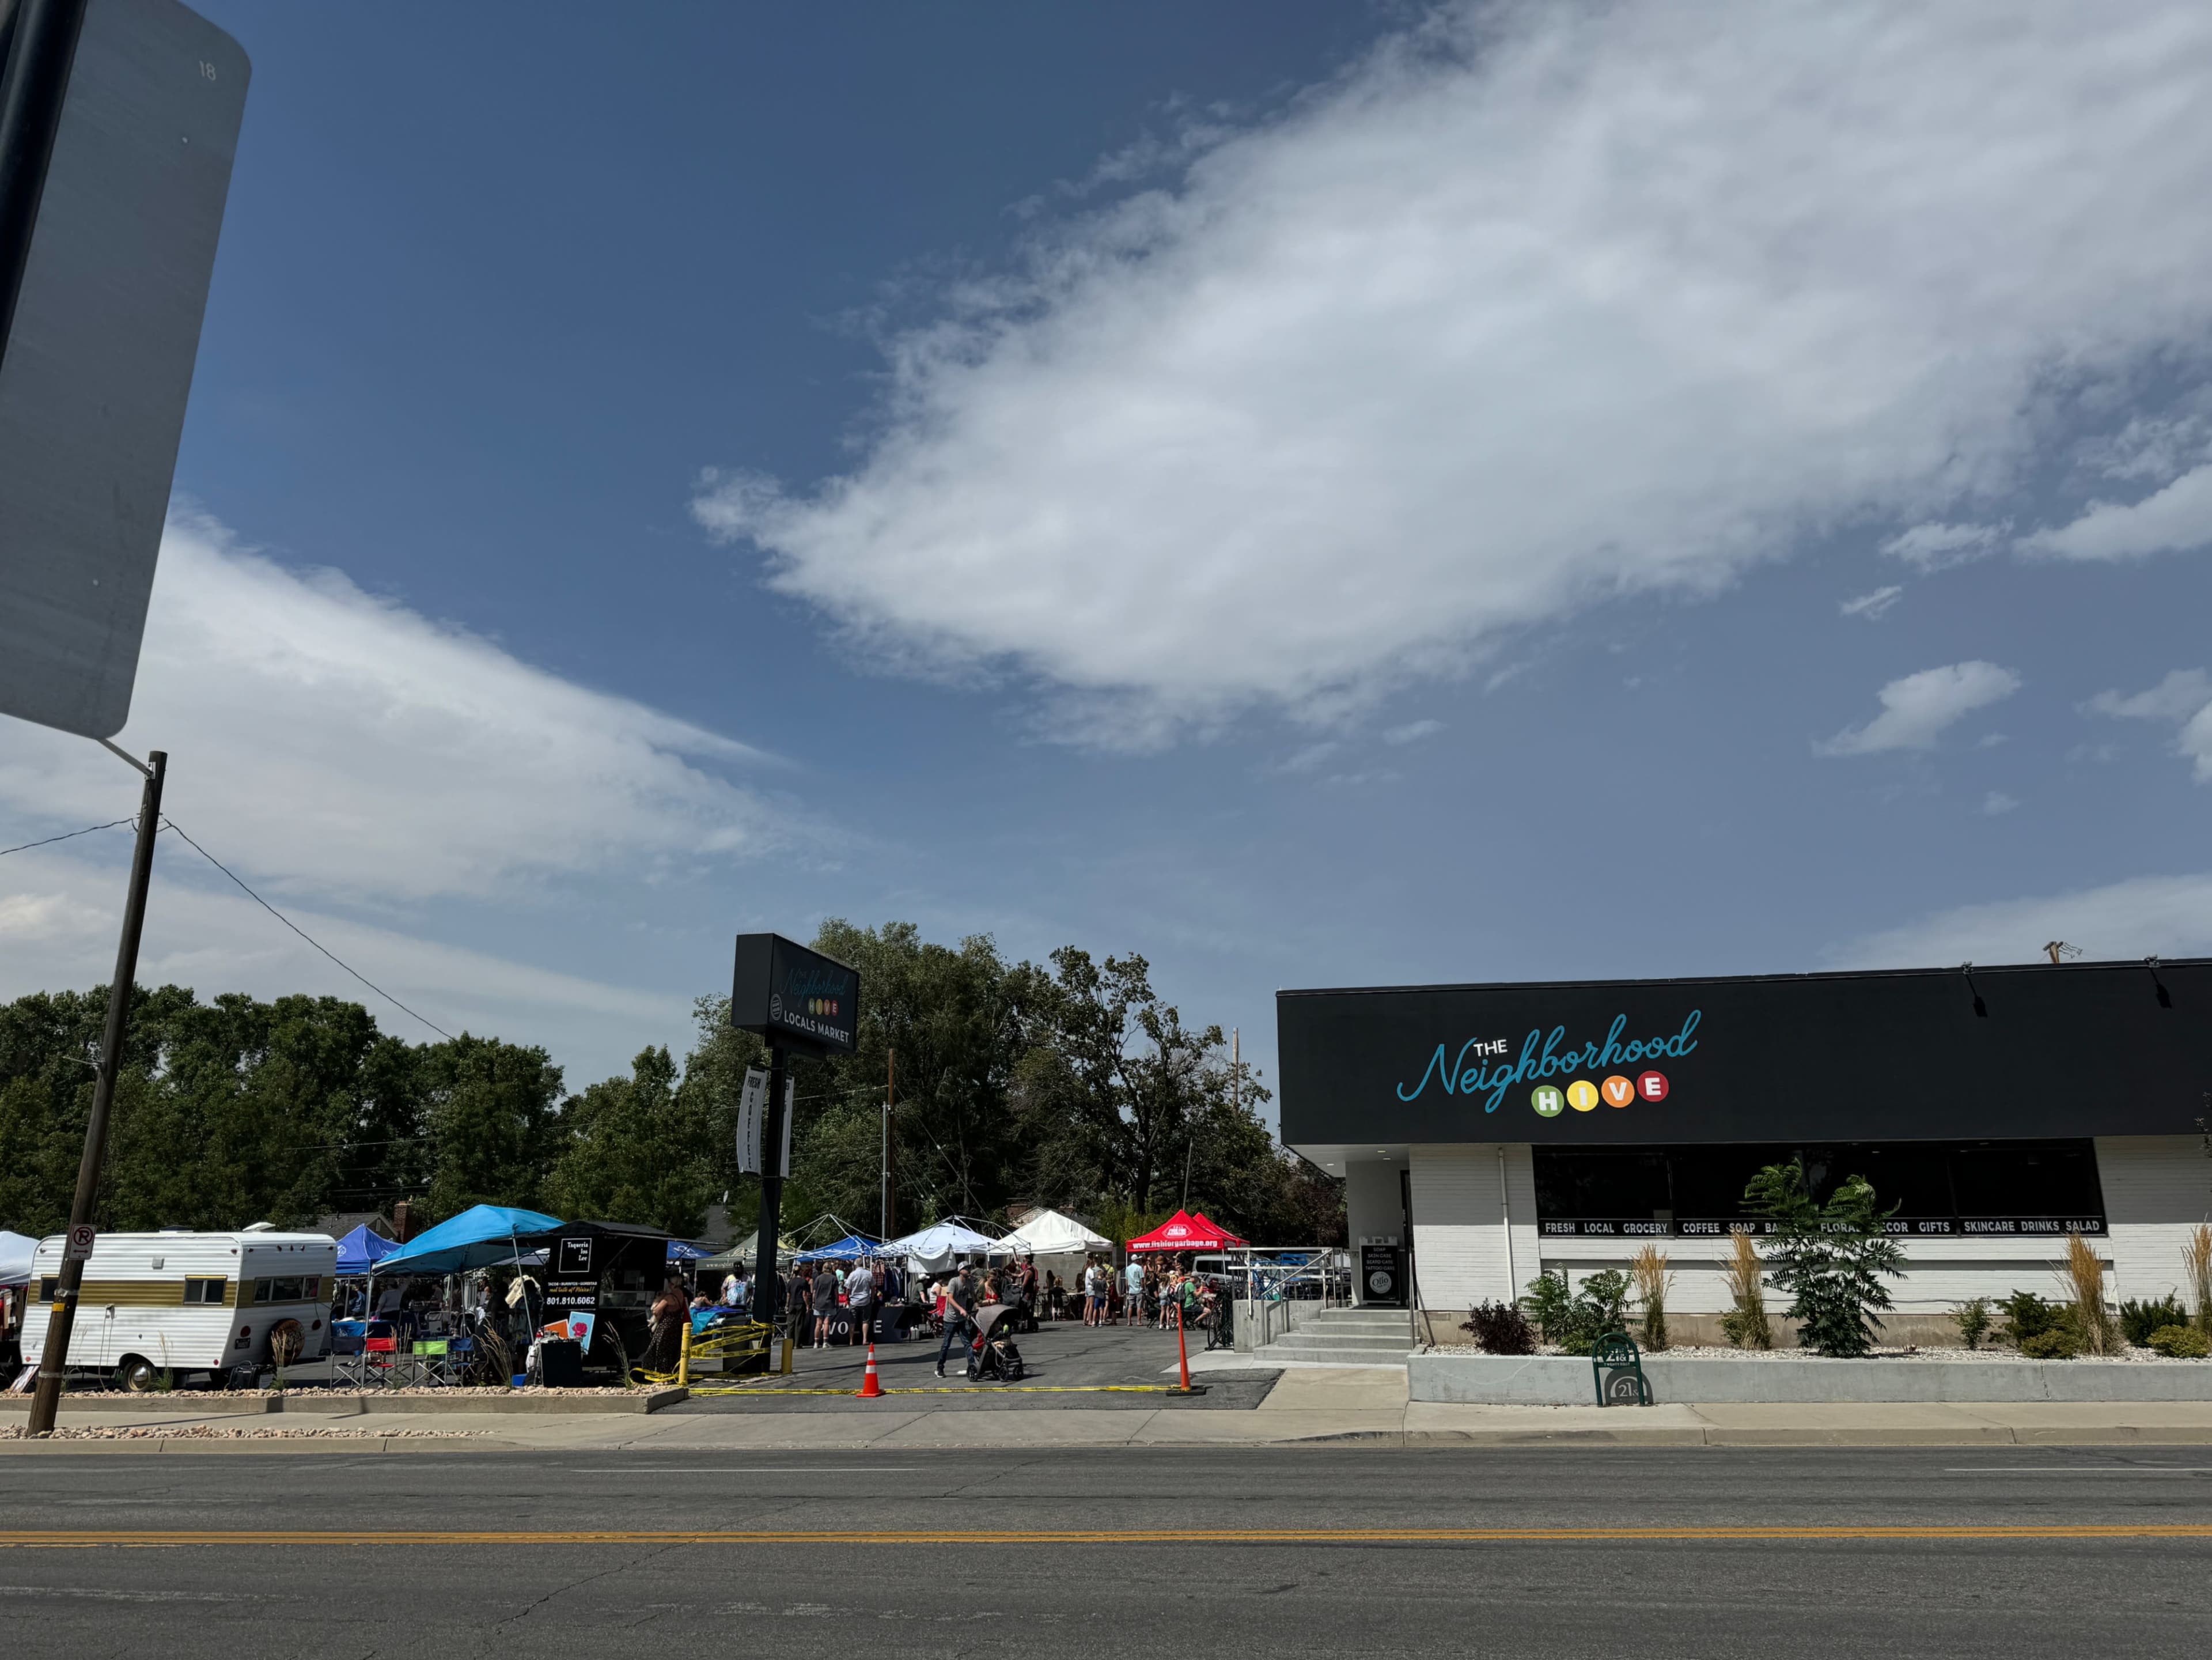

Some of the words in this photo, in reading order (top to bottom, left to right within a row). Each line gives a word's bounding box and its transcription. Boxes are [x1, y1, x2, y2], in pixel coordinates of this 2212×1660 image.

[199, 60, 216, 81] 18
[780, 968, 849, 1007] Neighborhood
[809, 1000, 838, 1014] HIVE
[784, 1009, 815, 1032] LOCALS
[818, 1022, 849, 1043] MARKET
[1474, 1039, 1508, 1057] THE
[1397, 1009, 1701, 1113] Neighborhood
[748, 1076, 762, 1090] FRESH
[1537, 1076, 1663, 1112] HIVE
[1546, 1223, 1575, 1233] FRESH
[1585, 1223, 1614, 1233] LOCAL
[1623, 1223, 1668, 1233] GROCERY
[1683, 1223, 1720, 1233] COFFEE
[1729, 1222, 1755, 1234] SOAP
[1919, 1221, 1950, 1232] GIFTS
[1964, 1221, 2015, 1232] SKINCARE
[2021, 1220, 2059, 1232] DRINKS
[2066, 1220, 2100, 1231] SALAD
[1132, 1239, 1218, 1249] www.fishforgarbage.org
[547, 1296, 596, 1305] 801.810.6062
